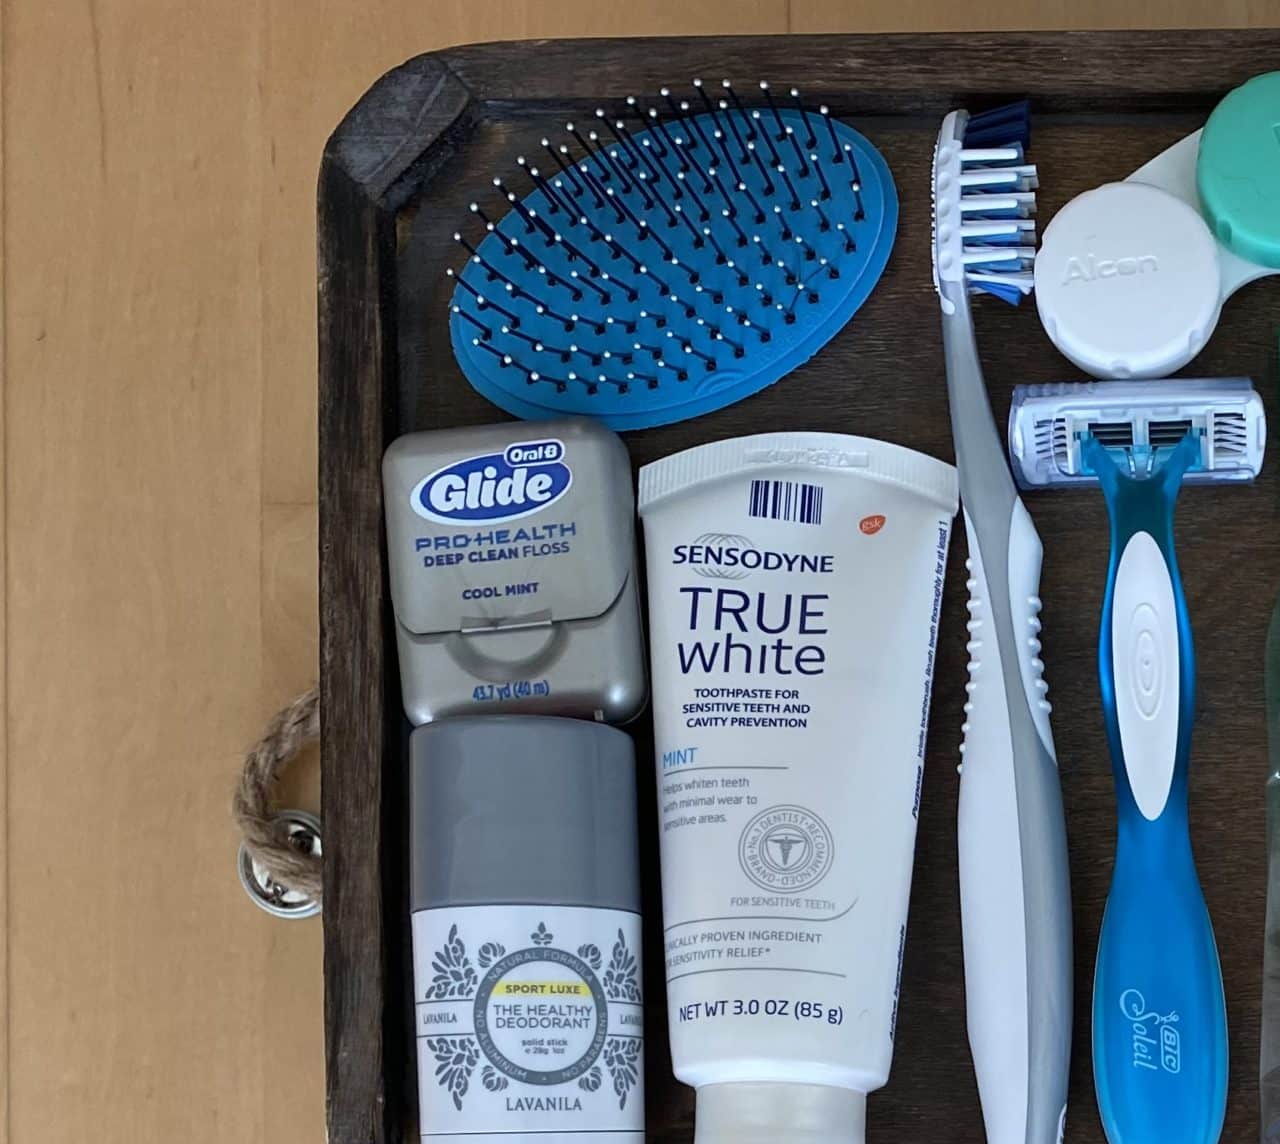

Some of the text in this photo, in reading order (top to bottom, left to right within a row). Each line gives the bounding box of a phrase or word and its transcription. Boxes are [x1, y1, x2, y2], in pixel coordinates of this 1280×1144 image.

[429, 466, 553, 513] Glide
[936, 528, 948, 550] least
[424, 542, 570, 567] DEEP CLEAN FLOSS
[673, 545, 834, 573] SENSODYNE
[935, 561, 943, 575] for
[462, 582, 539, 600] COOL MINT
[679, 587, 829, 634] TRUE
[677, 632, 826, 675] white
[472, 684, 494, 700] 43.7
[497, 683, 511, 699] yd
[513, 681, 530, 698] (40
[694, 688, 800, 700] TOOTHPASTE FOR
[682, 703, 810, 714] SENSITIVE TEETH AND
[686, 716, 807, 729] CAVITY PREVENTION
[663, 747, 698, 769] MINT
[663, 784, 683, 794] elps
[720, 778, 750, 788] teeth
[679, 795, 715, 809] minimal
[717, 796, 743, 806] wear
[746, 795, 757, 805] to
[760, 812, 807, 830] DENTIST
[781, 822, 825, 885] RECOMMENDED
[747, 854, 776, 883] BRAND
[731, 897, 836, 910] FOR SENSITIVE TEETH
[700, 931, 745, 943] PROVEN
[749, 930, 823, 944] INGREDIENT
[505, 984, 581, 994] SPORT LUXE
[423, 1012, 457, 1025] LAVANILA
[493, 1004, 593, 1017] THE HEALTHY
[680, 1000, 843, 1025] NET WT 3.0 OZ (85 g)
[495, 1017, 591, 1029] DEODORANT
[1119, 988, 1158, 1070] Soleil
[1163, 1030, 1178, 1069] BIC
[506, 1097, 582, 1112] LAVANILA
